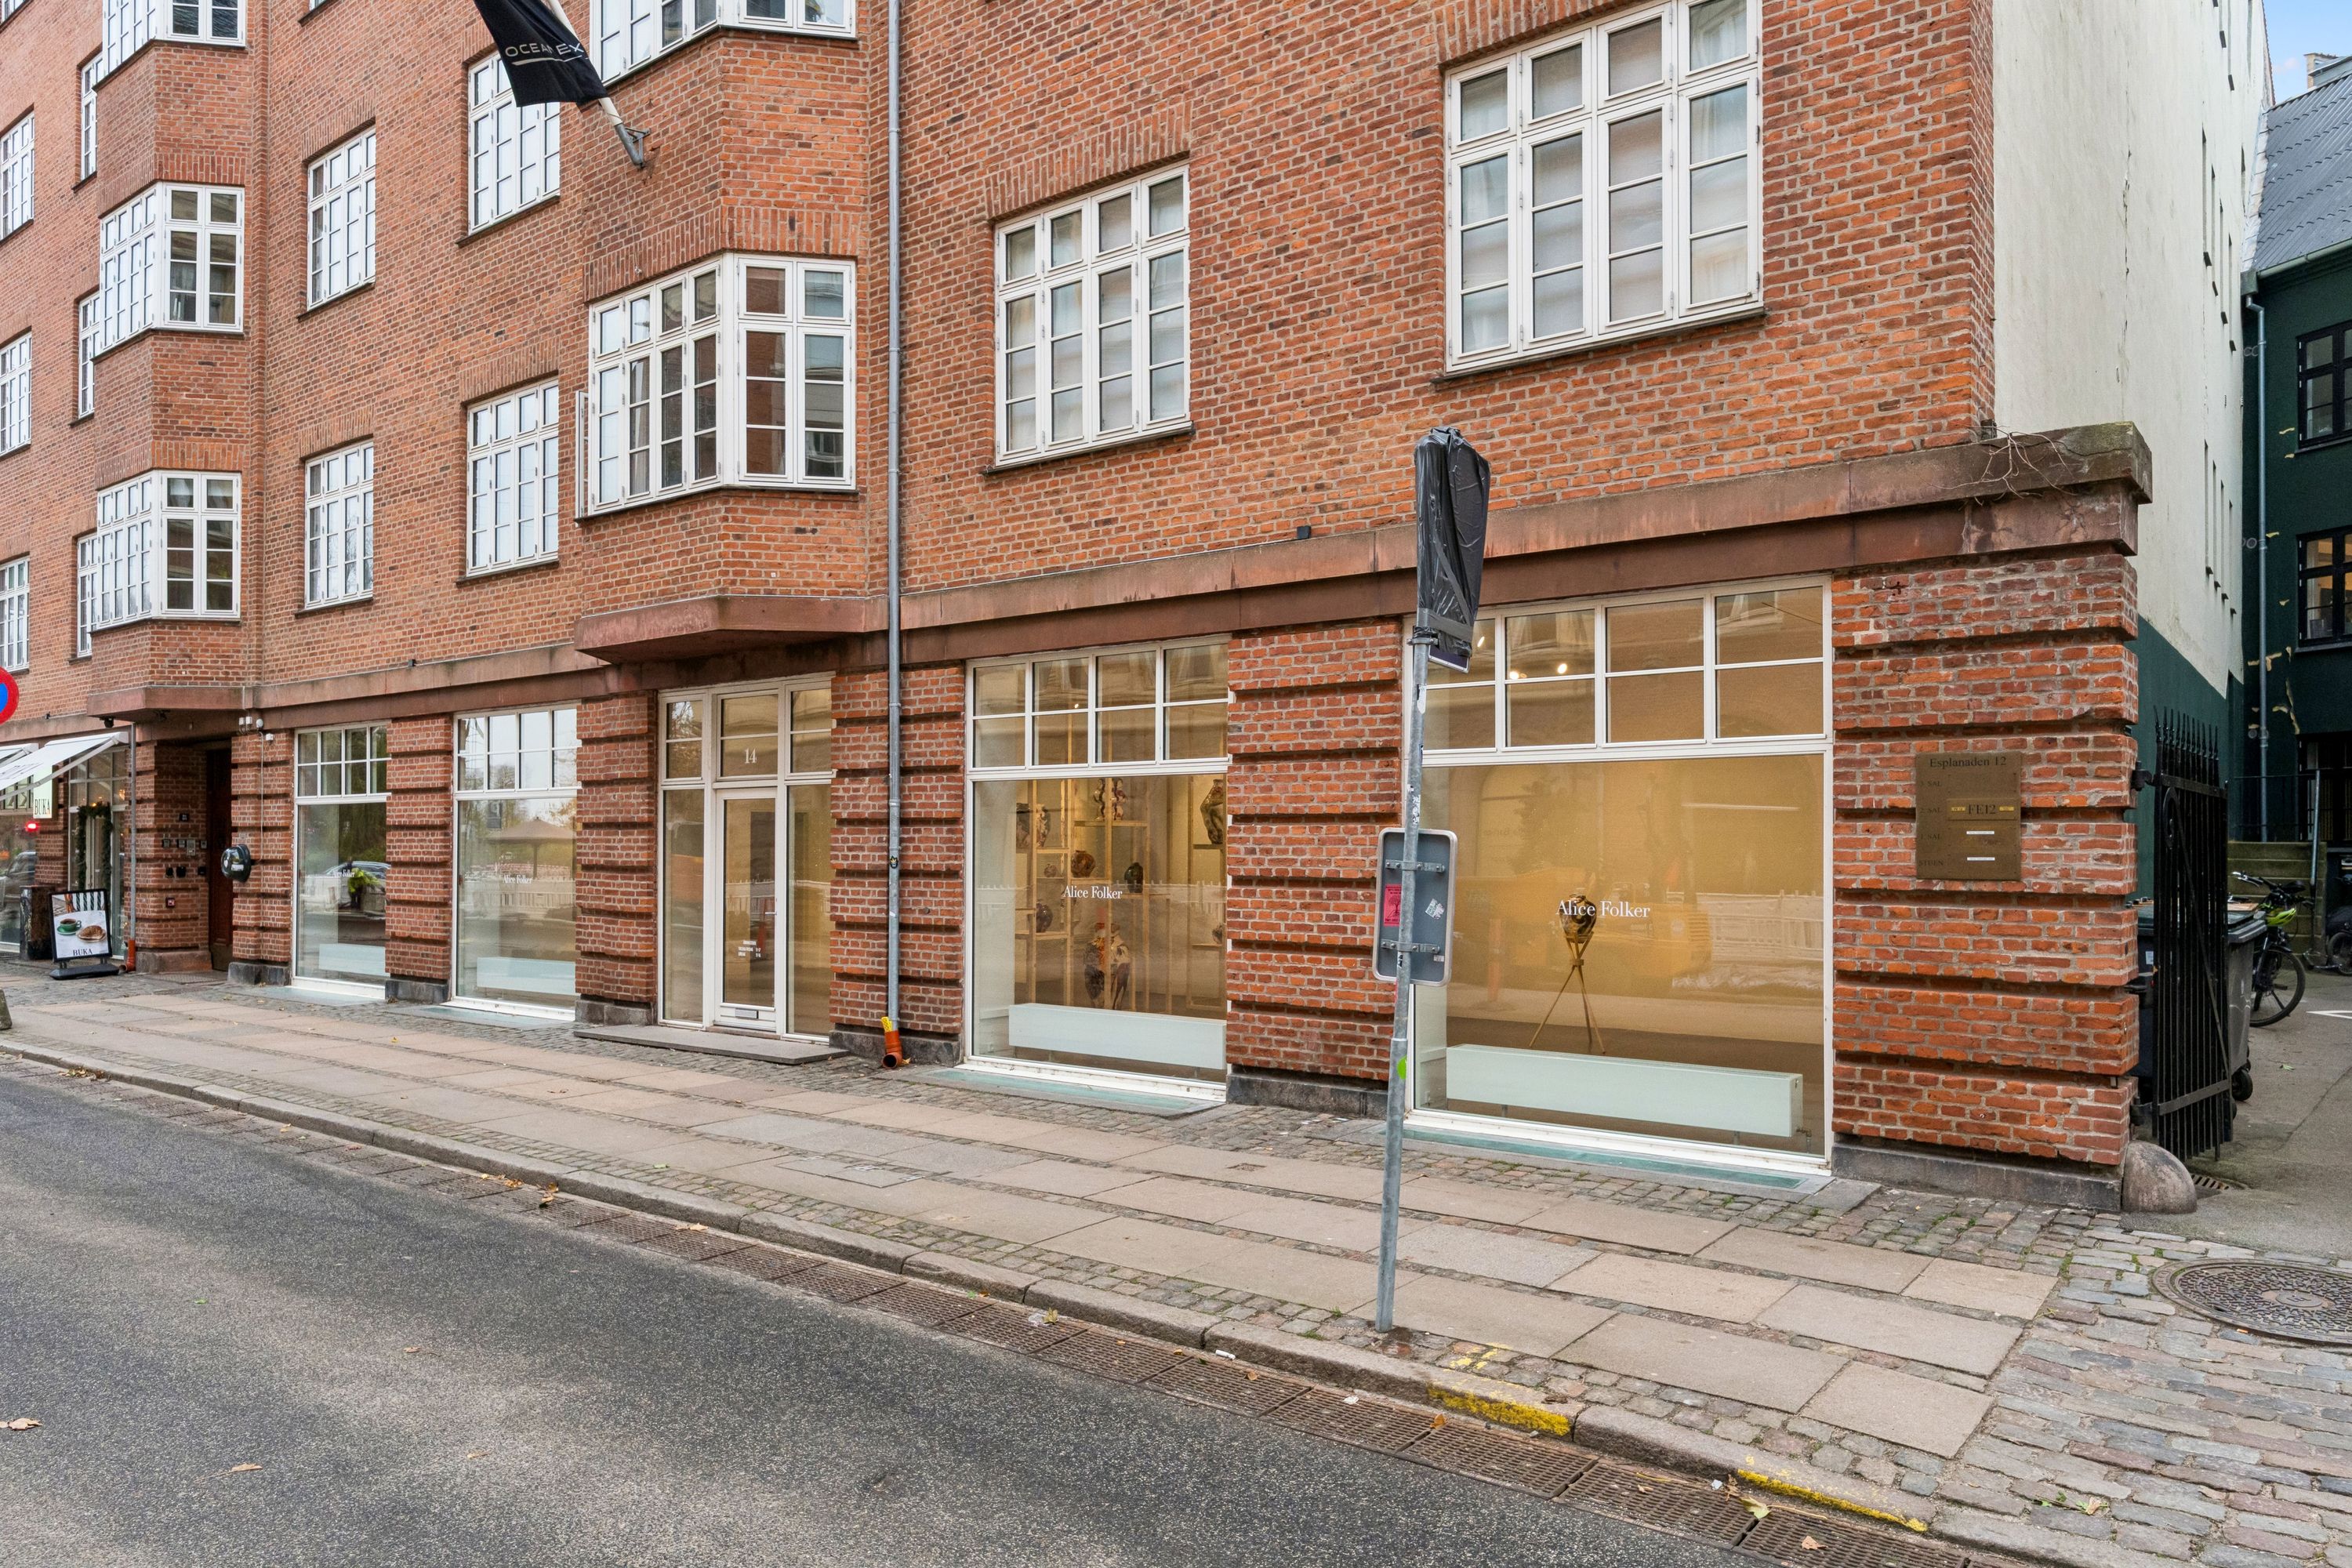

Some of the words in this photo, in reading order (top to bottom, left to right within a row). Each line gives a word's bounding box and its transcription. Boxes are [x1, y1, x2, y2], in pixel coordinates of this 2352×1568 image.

[744, 746, 757, 764] 14
[1929, 757, 1990, 769] Esplanaden
[1994, 756, 2007, 766] 12
[34, 798, 51, 815] BUKA
[1062, 885, 1088, 898] Alice
[1091, 885, 1123, 899] Folker
[1555, 899, 1595, 916] Alice
[1599, 900, 1650, 918] Folker
